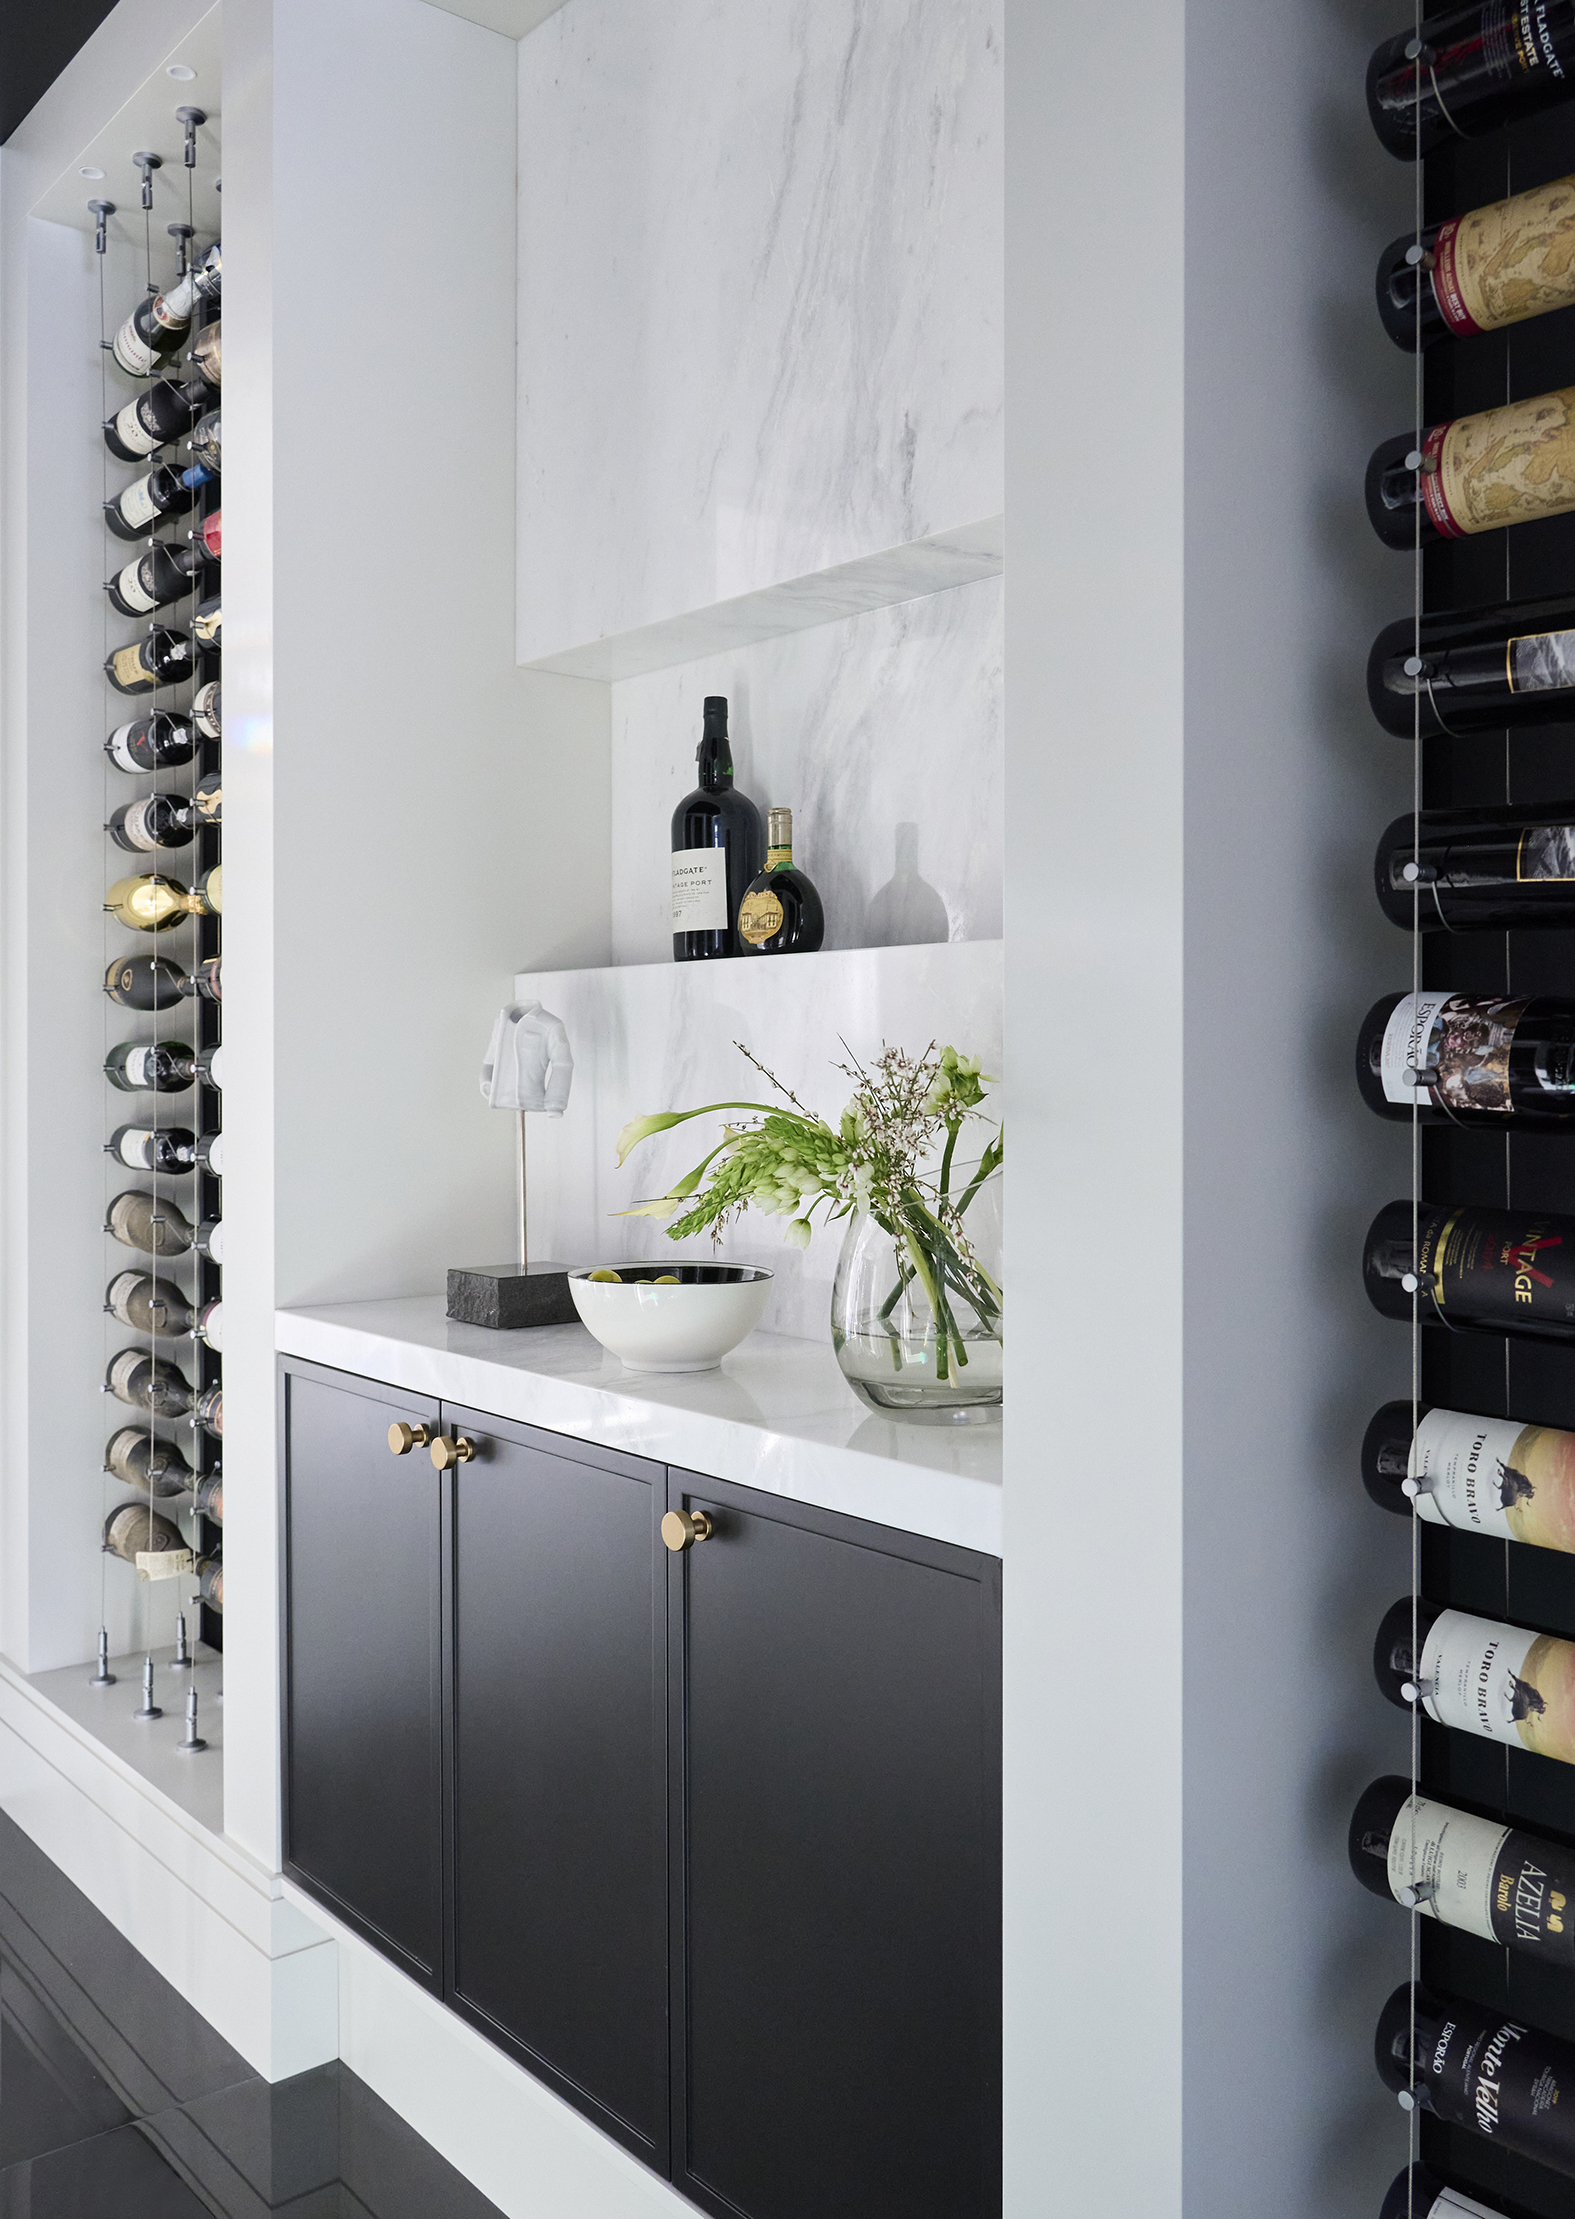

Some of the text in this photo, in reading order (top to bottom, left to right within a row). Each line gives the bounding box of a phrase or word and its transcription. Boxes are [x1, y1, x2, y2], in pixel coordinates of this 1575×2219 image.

[1520, 16, 1540, 67] ESTATE
[691, 879, 712, 887] PORT
[1406, 1003, 1436, 1069] ESPORÃO
[1500, 1241, 1513, 1266] PORT
[1514, 1220, 1549, 1304] VINTAGE
[1466, 1434, 1488, 1524] TORO BRAVO
[1435, 1654, 1443, 1696] VALENCIA
[1477, 1641, 1500, 1732] TORO BRAVO
[1457, 1870, 1468, 1889] 2003
[1497, 1873, 1515, 1912] Barolo
[1515, 1860, 1548, 1941] AZELIA
[1432, 2021, 1457, 2074] ESPORÃO
[1461, 2044, 1473, 2070] PORTUGAL
[1475, 2022, 1528, 2134] Monte Velho
